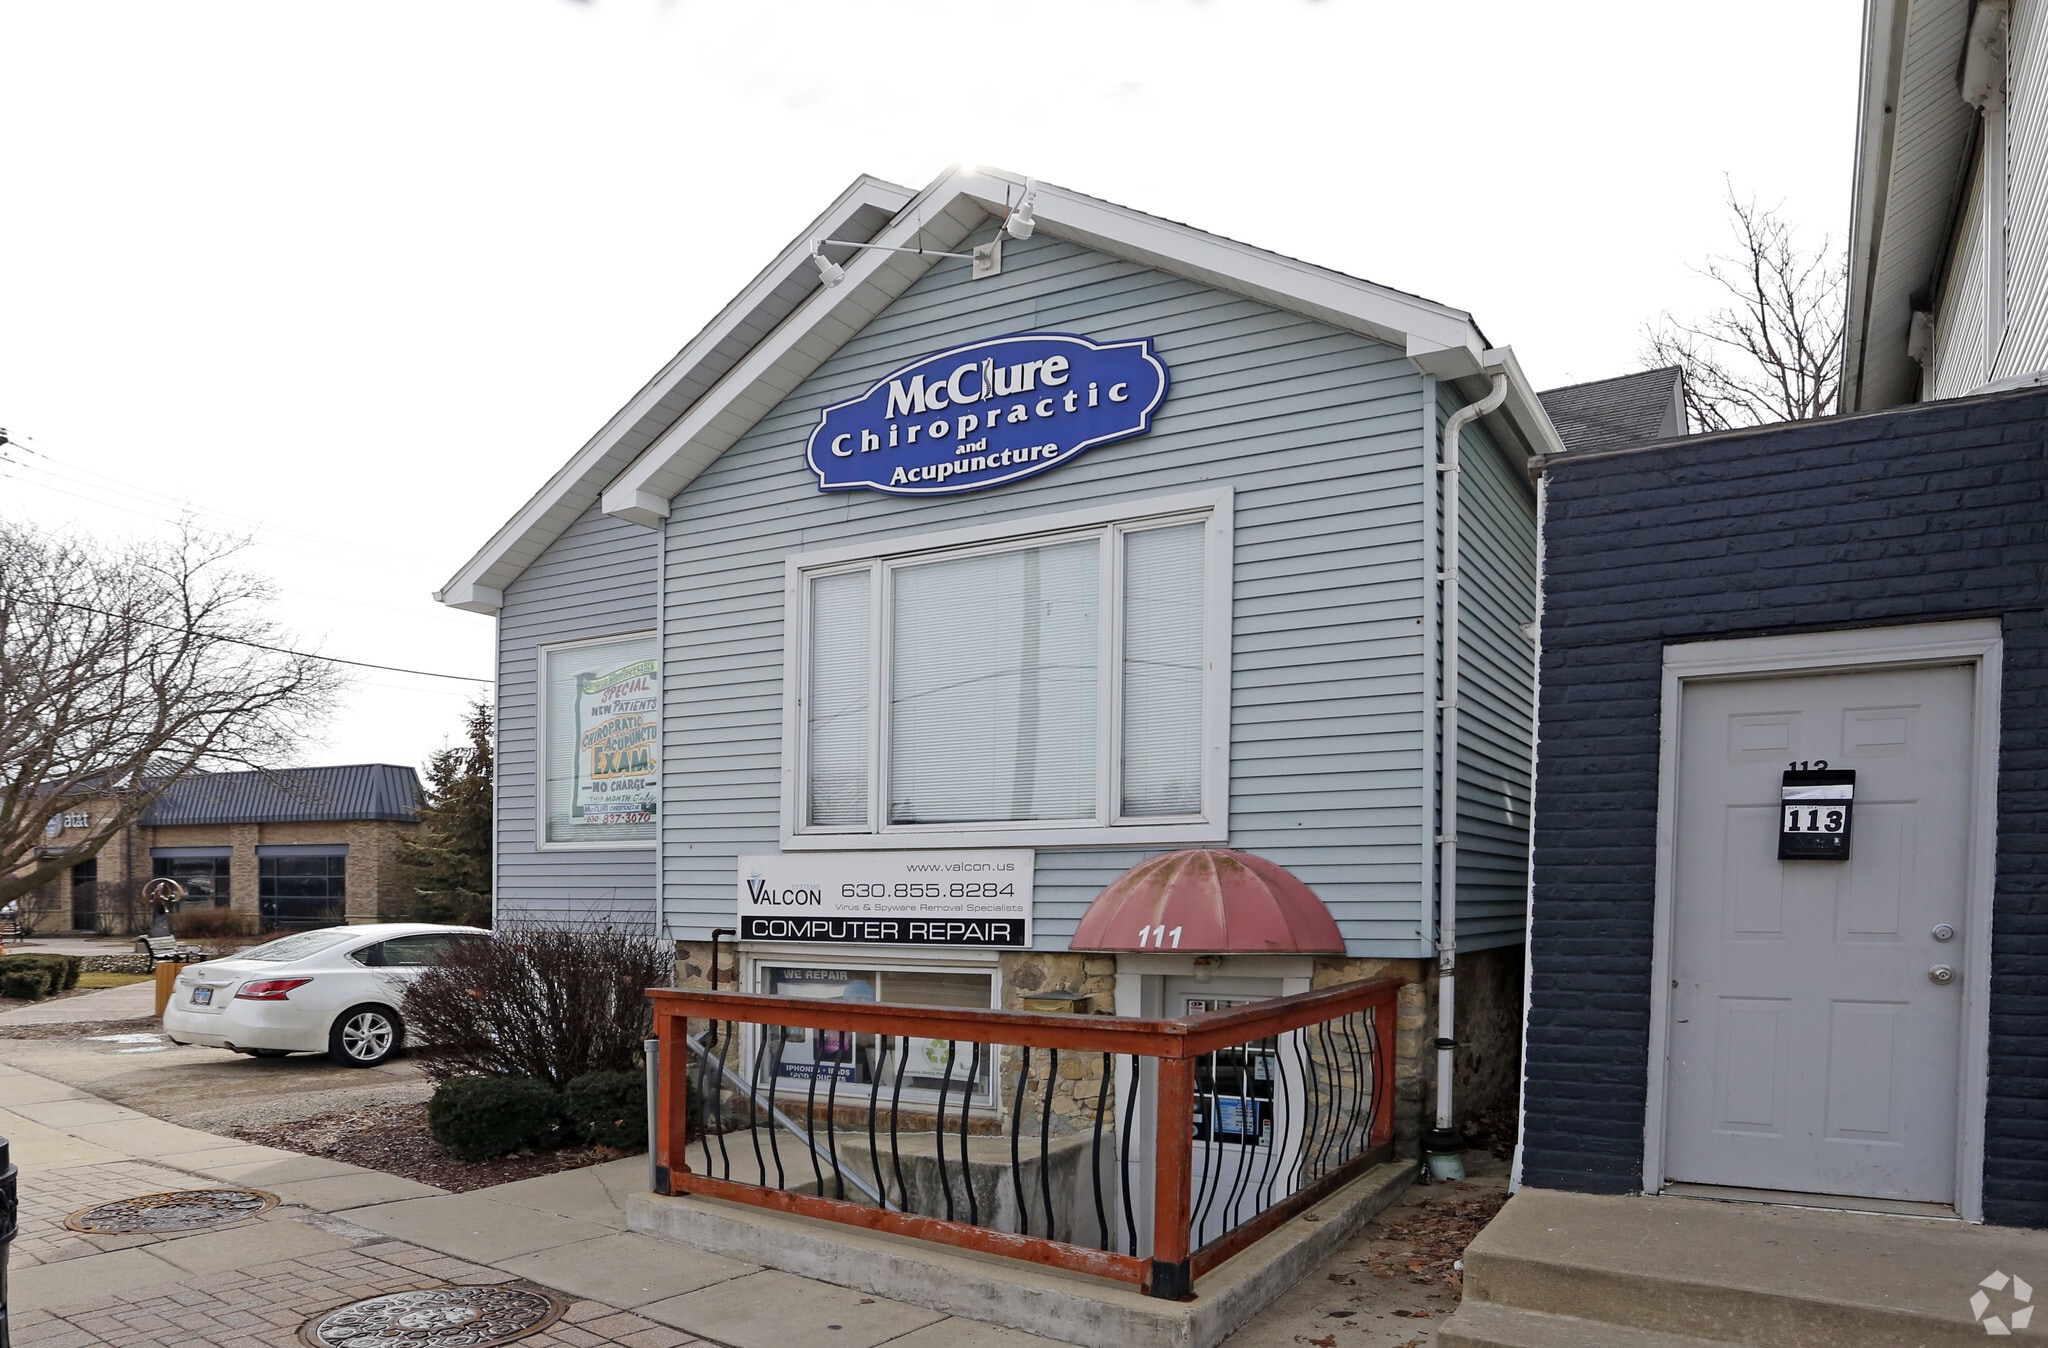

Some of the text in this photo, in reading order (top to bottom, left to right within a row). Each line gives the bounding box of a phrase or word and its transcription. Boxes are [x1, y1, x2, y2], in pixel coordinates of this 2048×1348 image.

[884, 354, 1069, 419] McClure
[831, 381, 1129, 457] Chiropractic
[955, 438, 987, 455] and
[889, 441, 1058, 486] Acupuncture
[601, 677, 650, 703] SPECIAL
[591, 704, 612, 717] NEW
[592, 779, 645, 793] NO CHARGE
[605, 794, 631, 802] MONTH
[63, 811, 89, 828] at&t
[1788, 809, 1843, 832] 113
[906, 862, 1015, 872] www.valcon.us
[841, 883, 1015, 898] 630.855.8284
[835, 903, 1024, 913] Virus & Spyware Removal Specialists
[752, 920, 1011, 942] COMPUTER REPAIR
[1138, 924, 1183, 948] 111
[784, 970, 848, 980] WE REPAIR
